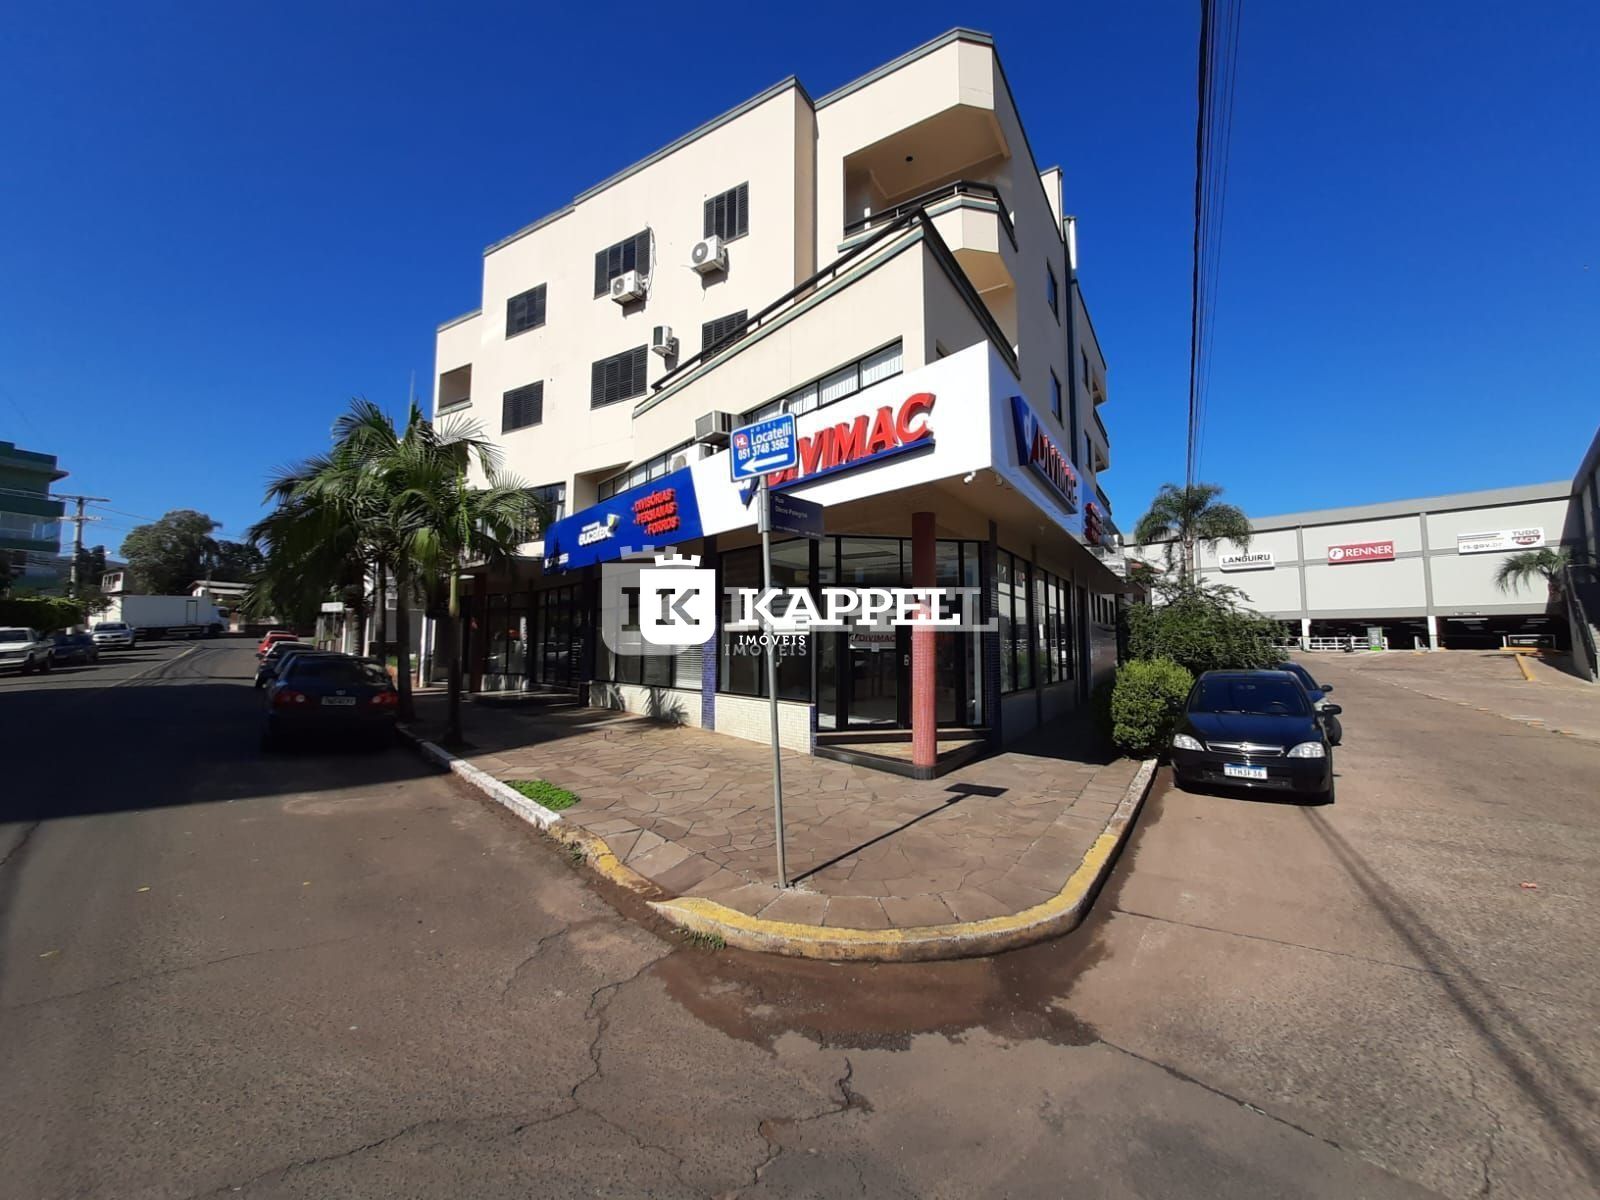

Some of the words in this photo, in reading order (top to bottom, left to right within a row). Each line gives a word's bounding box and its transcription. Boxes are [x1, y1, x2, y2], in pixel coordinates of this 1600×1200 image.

[751, 421, 792, 446] Locatelli
[738, 446, 751, 460] 051
[752, 442, 770, 457] 3748
[1345, 545, 1393, 557] RENNER
[1222, 554, 1271, 564] LANGUIRU
